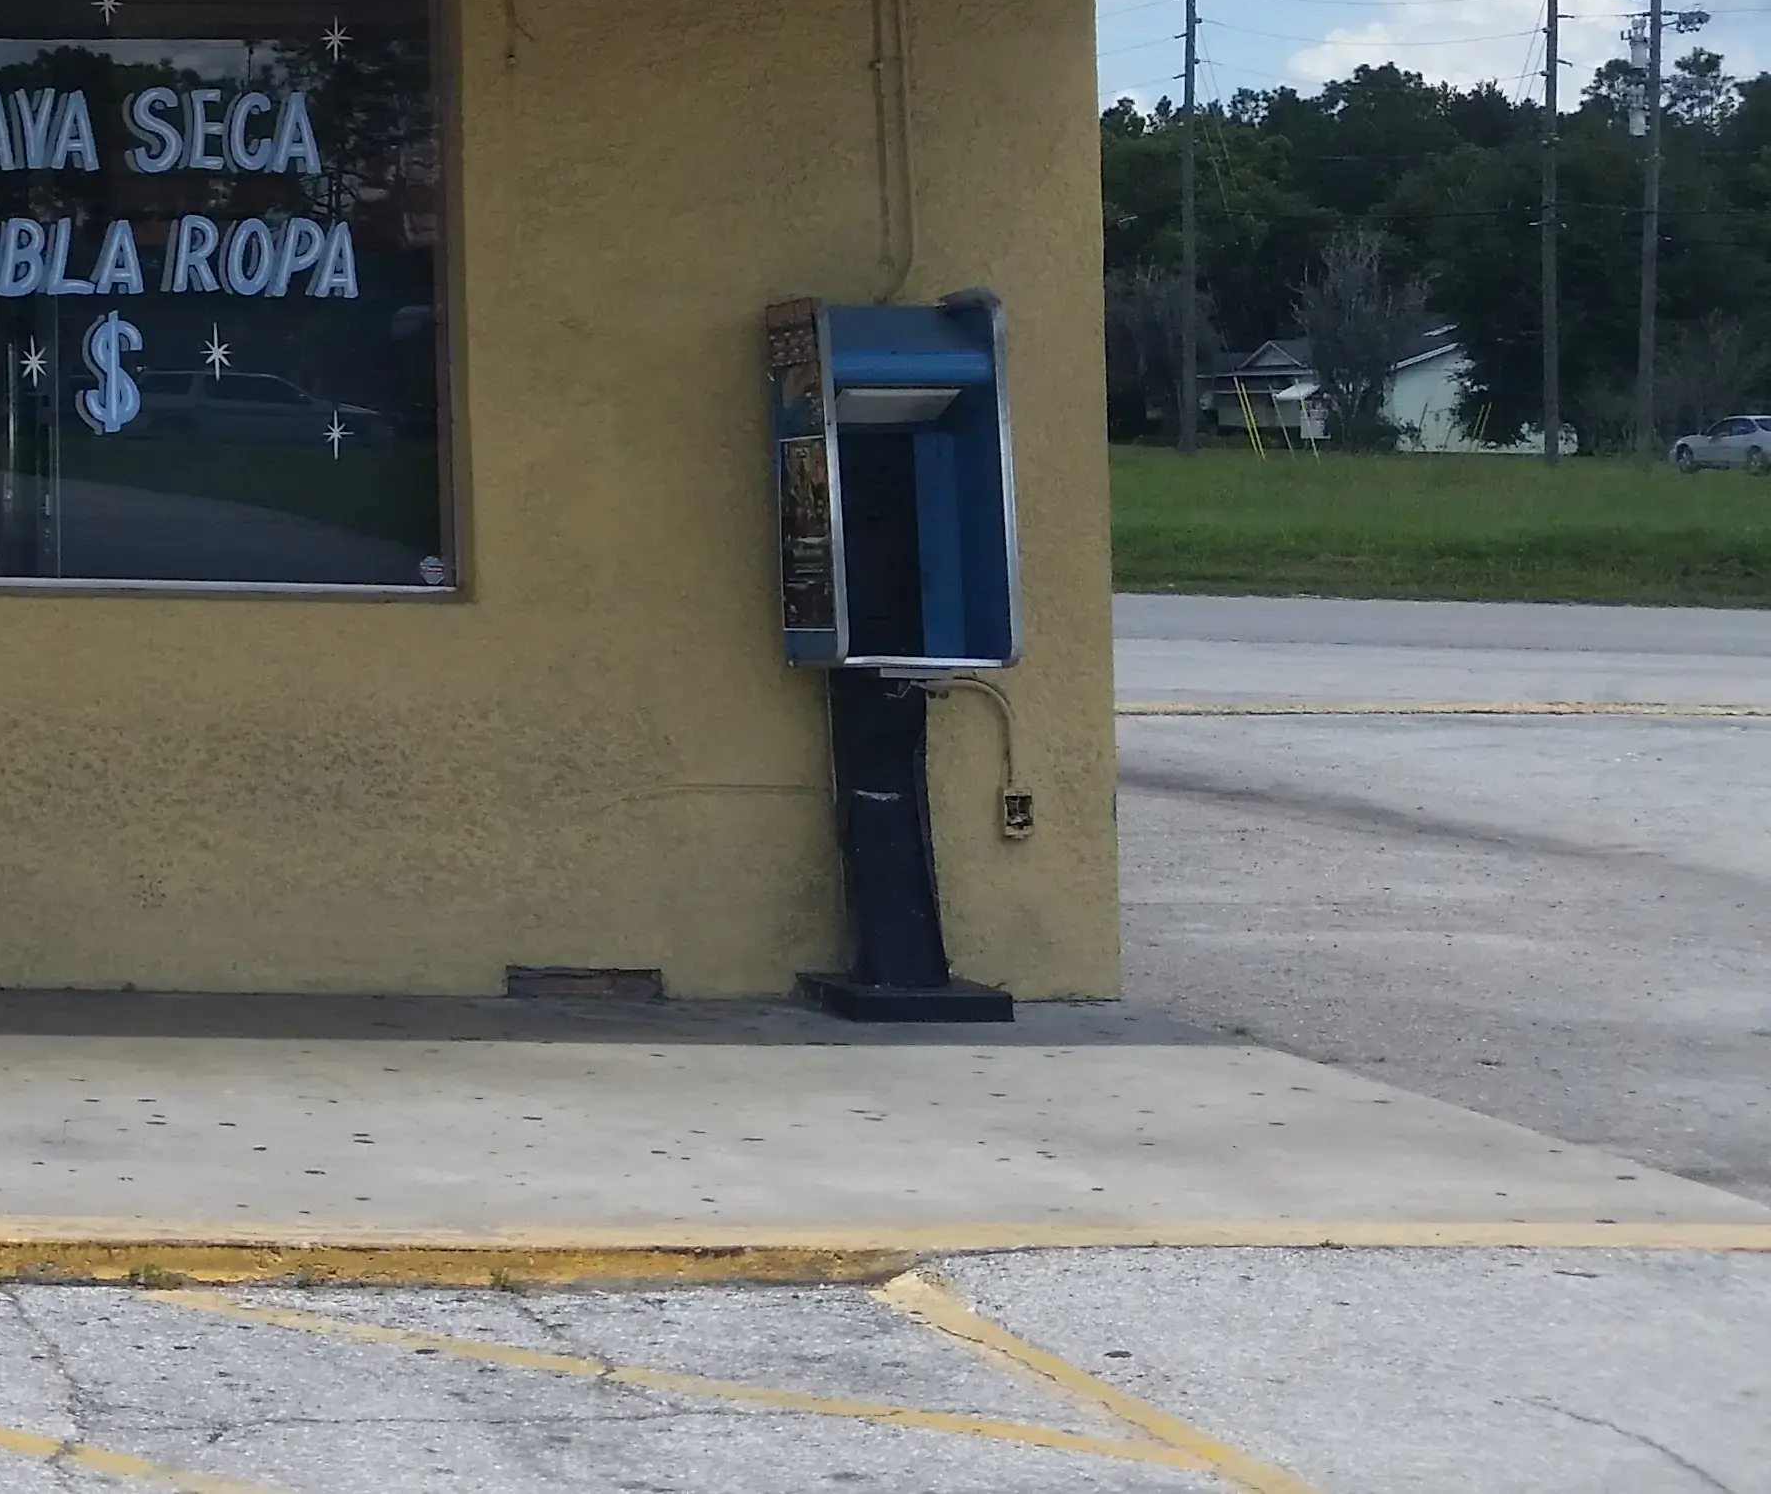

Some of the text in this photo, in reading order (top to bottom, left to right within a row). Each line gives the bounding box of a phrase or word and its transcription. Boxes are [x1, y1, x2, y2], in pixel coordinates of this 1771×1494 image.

[124, 86, 322, 175] SECA
[161, 214, 359, 299] ROPA
[75, 310, 143, 434] $
